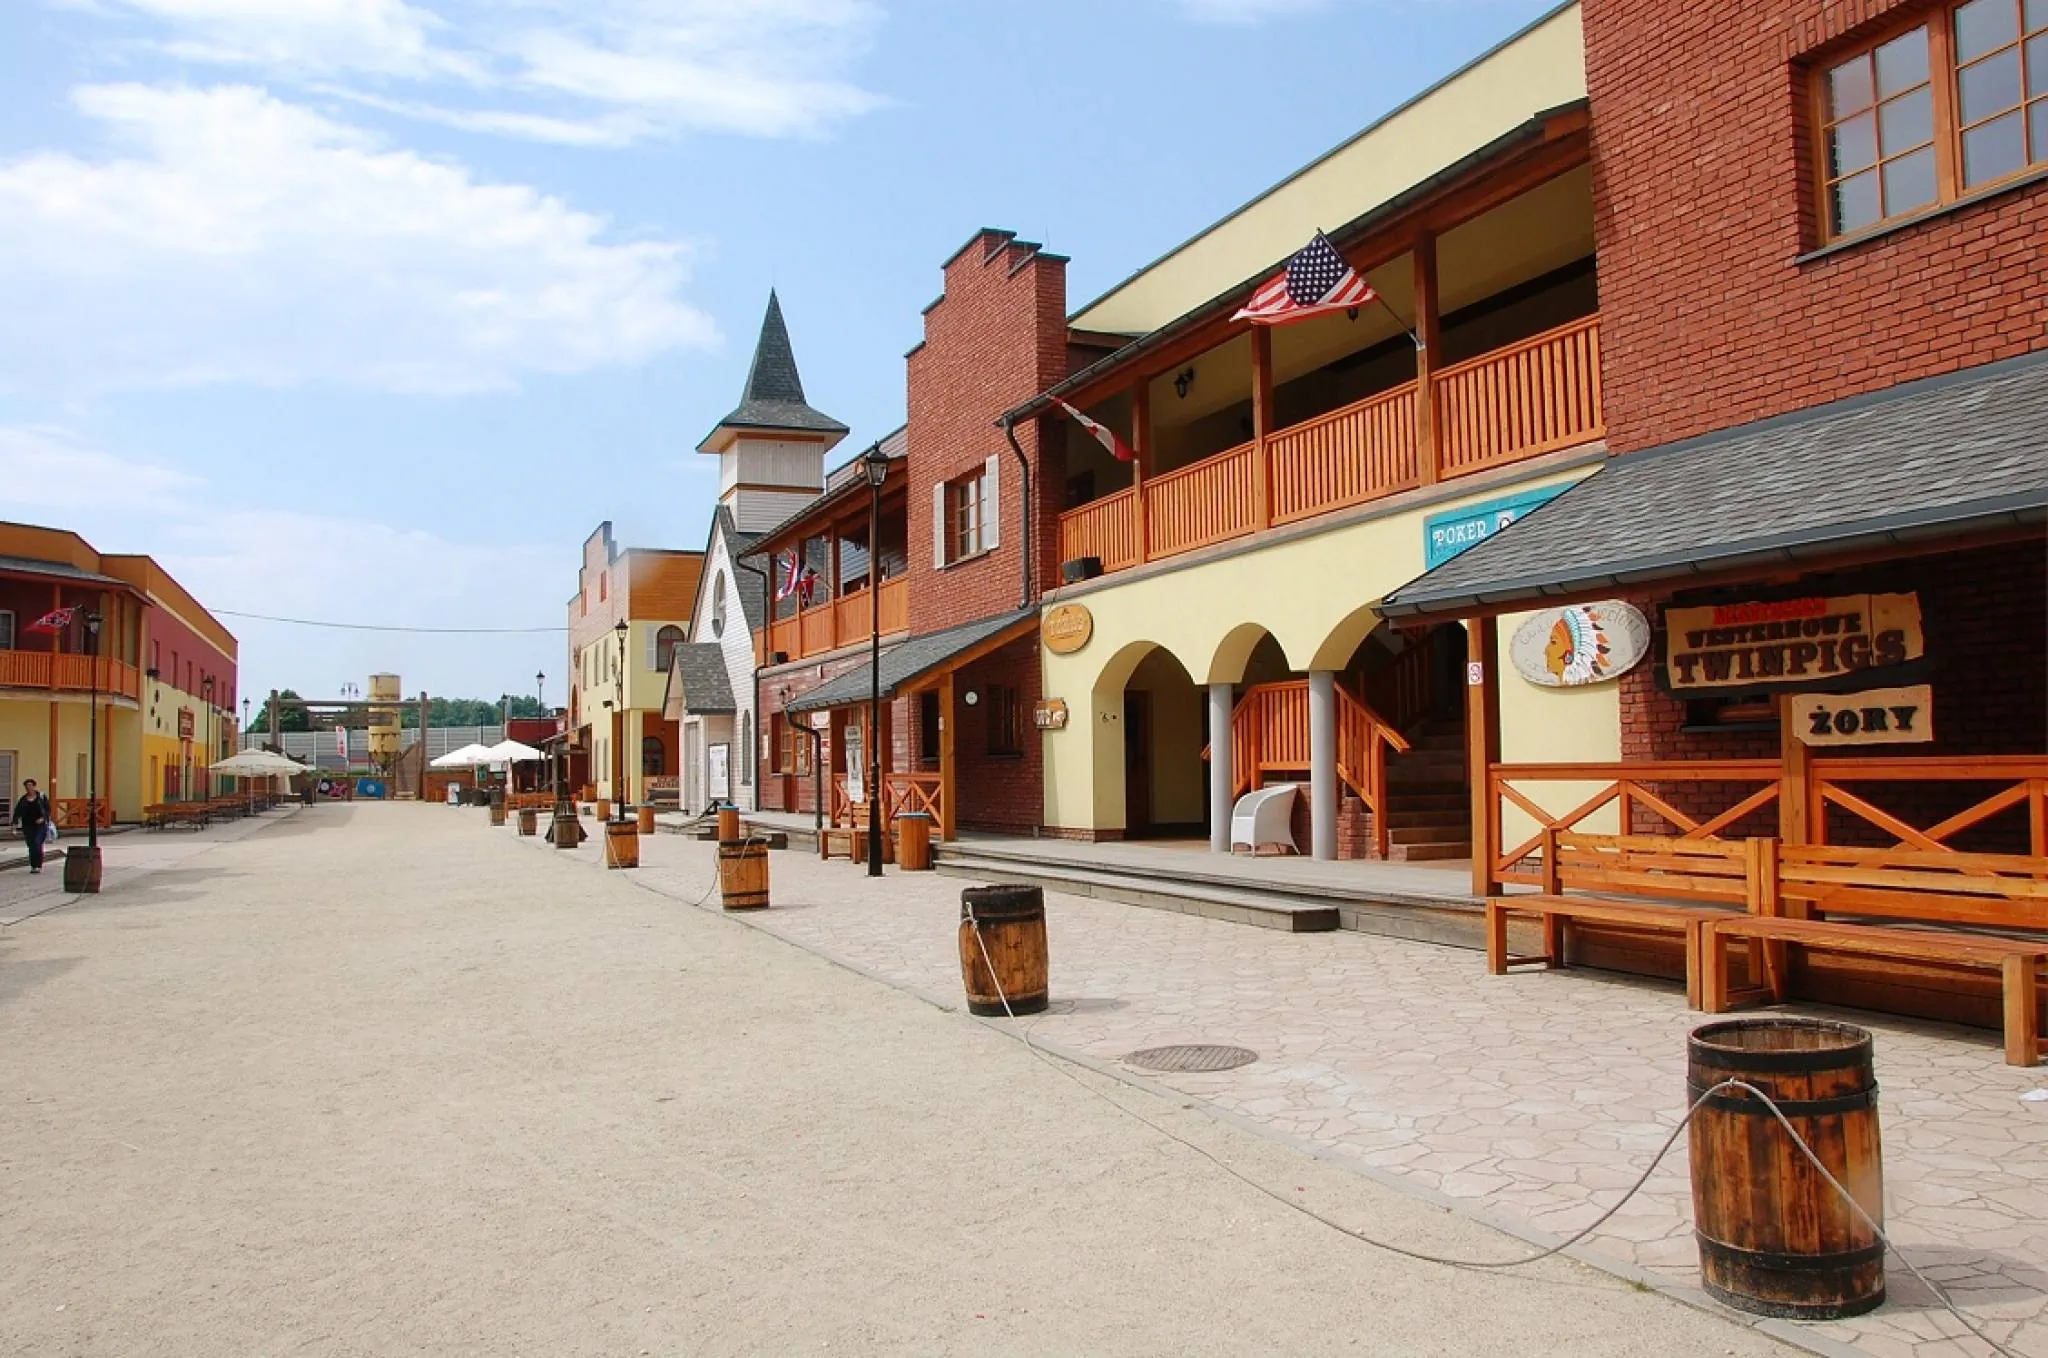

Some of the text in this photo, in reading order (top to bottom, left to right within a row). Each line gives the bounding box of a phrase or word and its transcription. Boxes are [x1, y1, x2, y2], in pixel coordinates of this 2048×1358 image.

[1433, 520, 1487, 546] POKER
[1674, 629, 1907, 683] TWINPIGS
[1809, 705, 1918, 735] ŻORY
